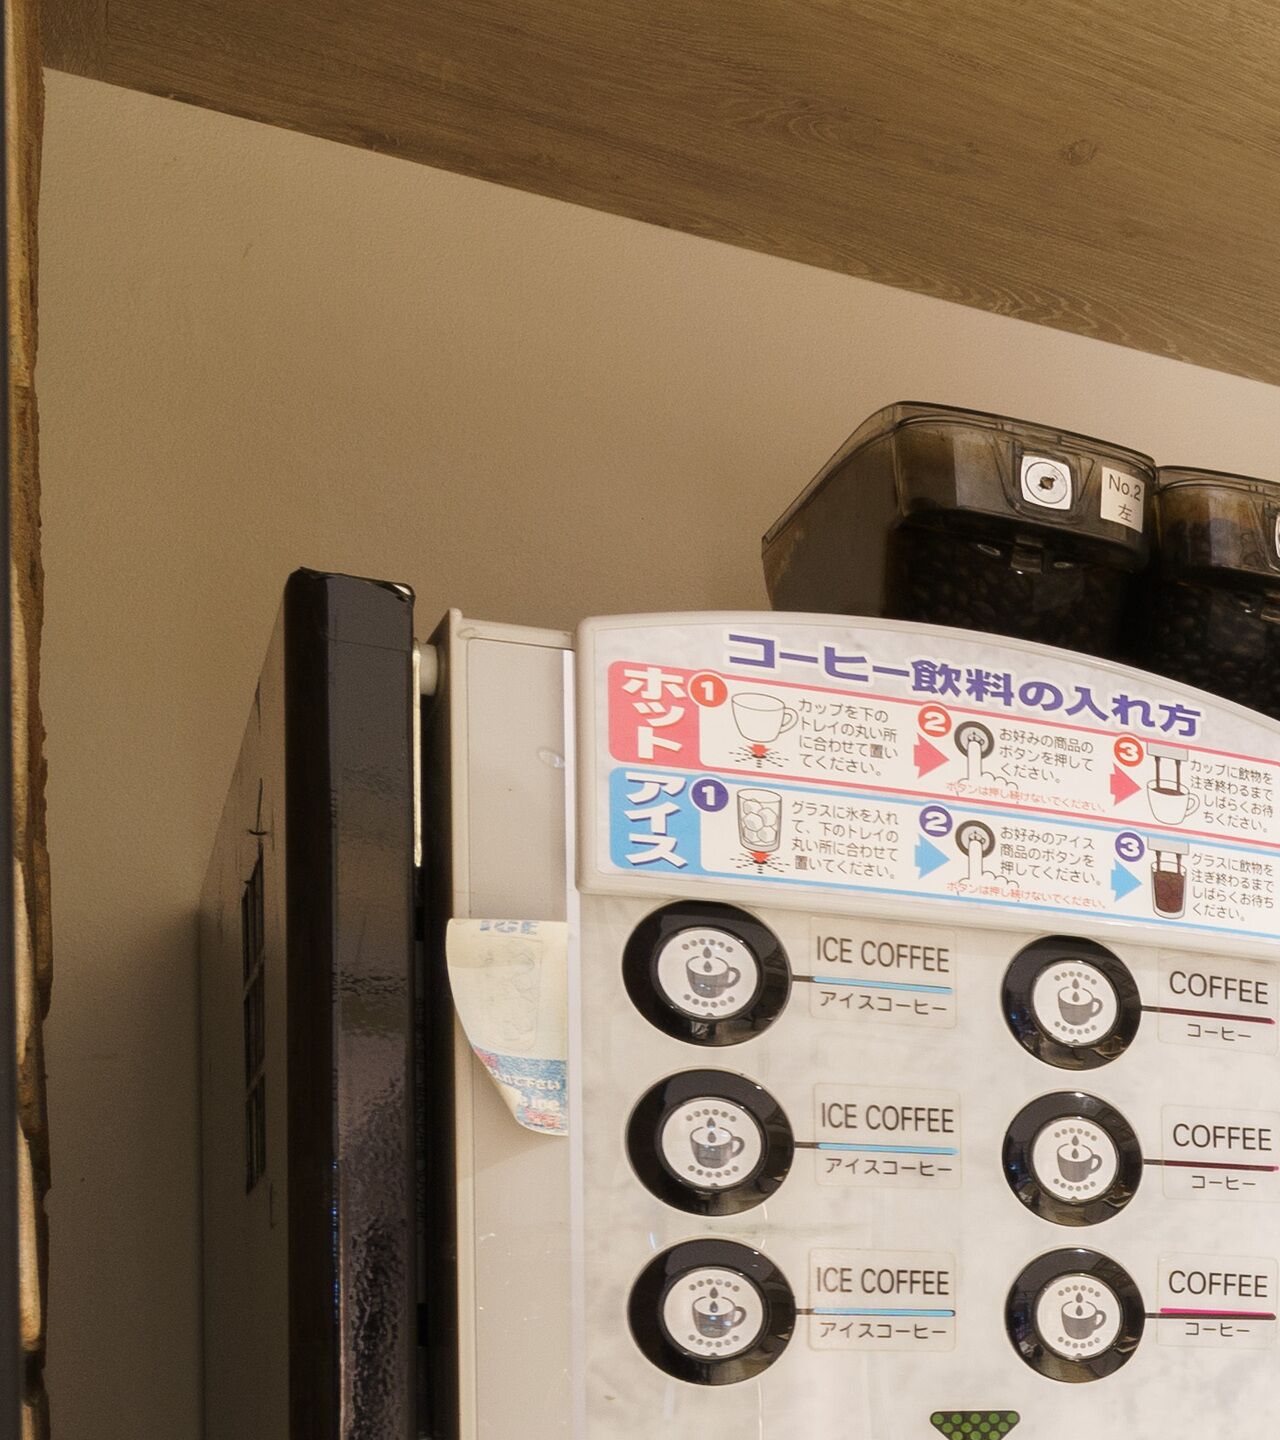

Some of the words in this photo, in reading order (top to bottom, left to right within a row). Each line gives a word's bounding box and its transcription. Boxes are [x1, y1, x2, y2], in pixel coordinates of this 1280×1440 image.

[1108, 474, 1141, 501] No.2
[1117, 504, 1133, 522] 左
[728, 633, 1203, 738] コーヒー飲料の入れ方
[622, 667, 687, 759] ホット
[799, 698, 888, 723] カップを下の
[800, 717, 898, 743] トレイの丸い所
[999, 727, 1094, 754] お好みの商品の
[799, 735, 898, 760] に合わせて置い
[999, 746, 1093, 772] ボタンを押して
[801, 753, 881, 776] てください。
[1000, 763, 1061, 784] ください。
[1190, 759, 1273, 785] カップに飲物を
[1190, 775, 1274, 801] 注ぎ終わるまで
[791, 801, 898, 826] グラスに氷を入れ
[1203, 794, 1274, 818] しばらくお待
[624, 772, 687, 868] アイス
[792, 819, 898, 843] て、下のトレイの
[1203, 810, 1269, 833] ちください。
[791, 837, 898, 861] 丸い所に合わせて
[1001, 826, 1095, 850] お好みのアイス
[794, 855, 895, 879] 置いてください。
[1000, 844, 1094, 868] 商品のボタンを
[1191, 852, 1274, 877] グラスに飲物を
[1000, 861, 1102, 886] 押してください。
[1191, 868, 1274, 893] 注ぎ終わるまで
[1192, 885, 1274, 909] しばらくお待ち
[1192, 903, 1245, 922] ください。
[816, 936, 852, 964] ICE
[860, 939, 950, 973] COFFEE
[1169, 971, 1268, 1004] COFFEE
[820, 990, 948, 1016] アイスコーヒー
[1187, 1023, 1252, 1042] コーヒー
[821, 1102, 857, 1129] ICE
[865, 1104, 954, 1134] COFFEE
[1172, 1123, 1272, 1151] COFFEE
[825, 1157, 952, 1177] アイスコーヒー
[1192, 1175, 1256, 1190] コーヒー
[816, 1267, 852, 1292] ICE
[860, 1268, 949, 1296] COFFEE
[1168, 1270, 1268, 1298] COFFEE
[820, 1322, 947, 1339] アイスコーヒー
[1186, 1322, 1250, 1337] コーヒー
